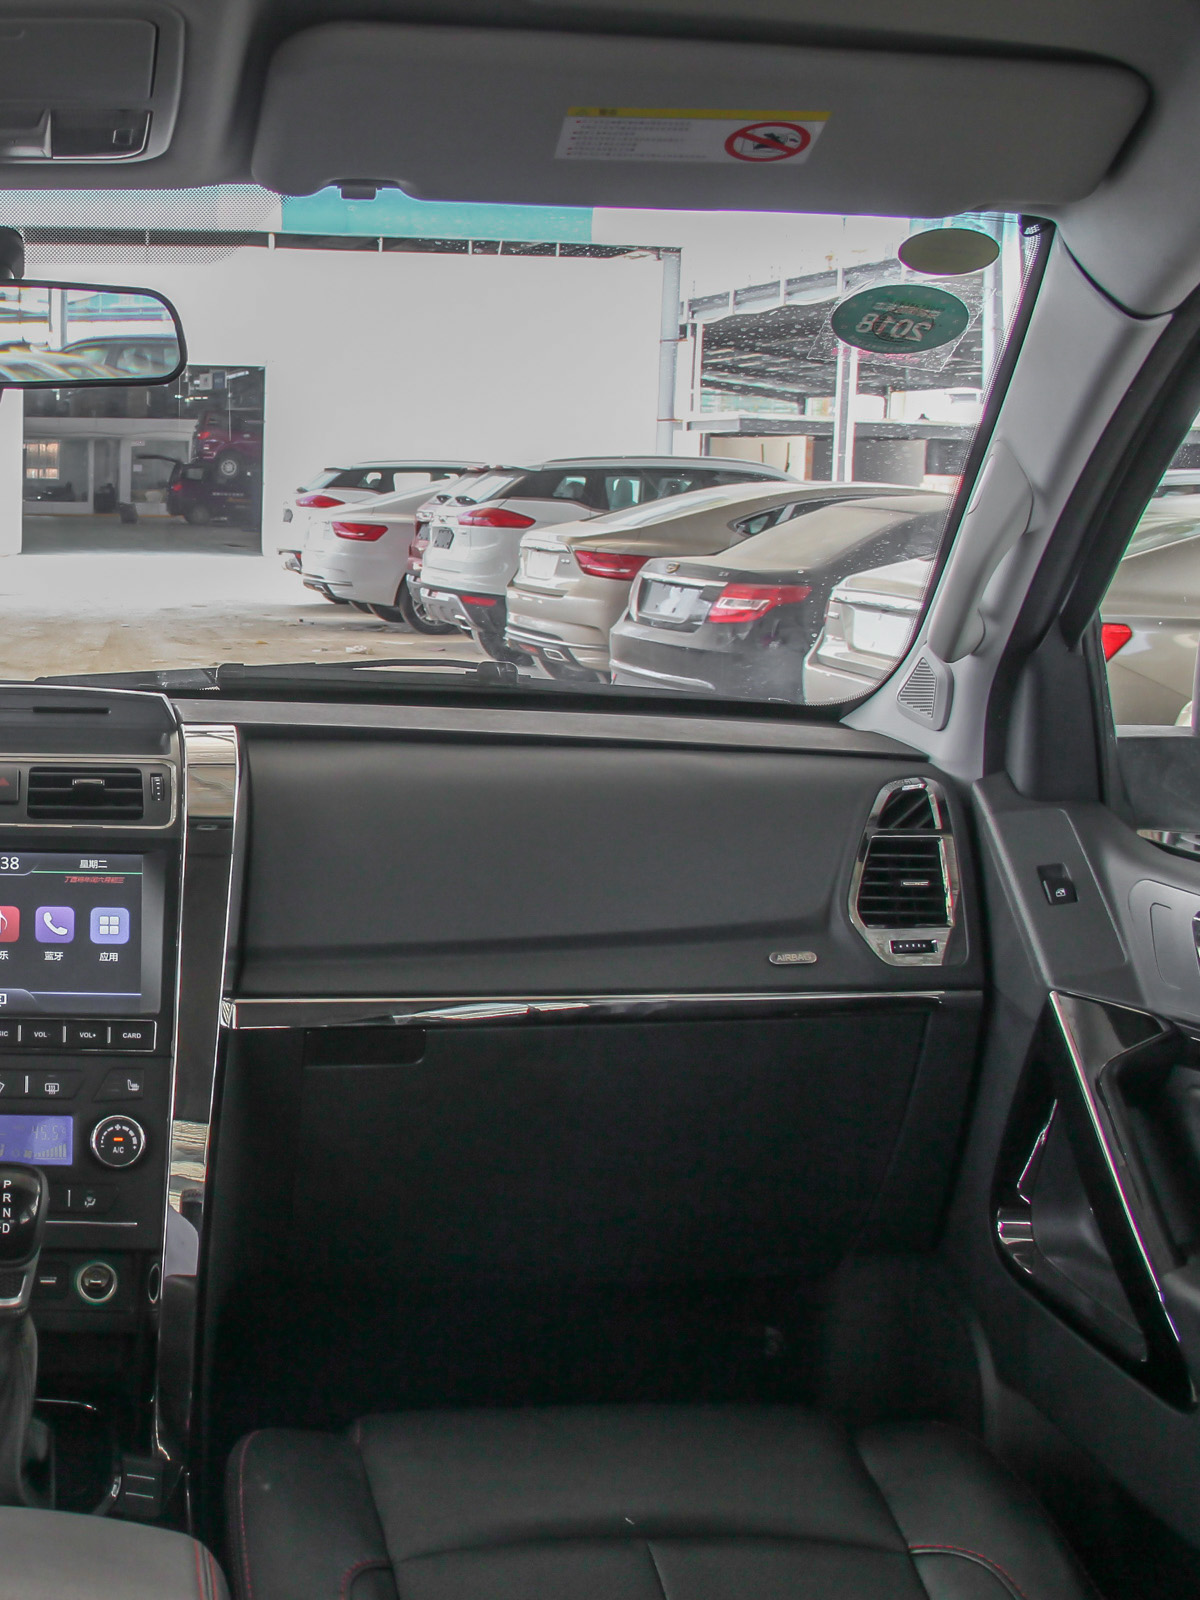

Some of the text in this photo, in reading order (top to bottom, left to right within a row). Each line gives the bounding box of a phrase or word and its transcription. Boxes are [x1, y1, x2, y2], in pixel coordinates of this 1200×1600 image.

[79, 859, 107, 869] 星期二
[44, 951, 64, 961] 蓝牙
[99, 952, 119, 962] 应用
[112, 1146, 125, 1154] A/C
[3, 1179, 12, 1189] P
[2, 1193, 12, 1203] R
[2, 1207, 11, 1218] N
